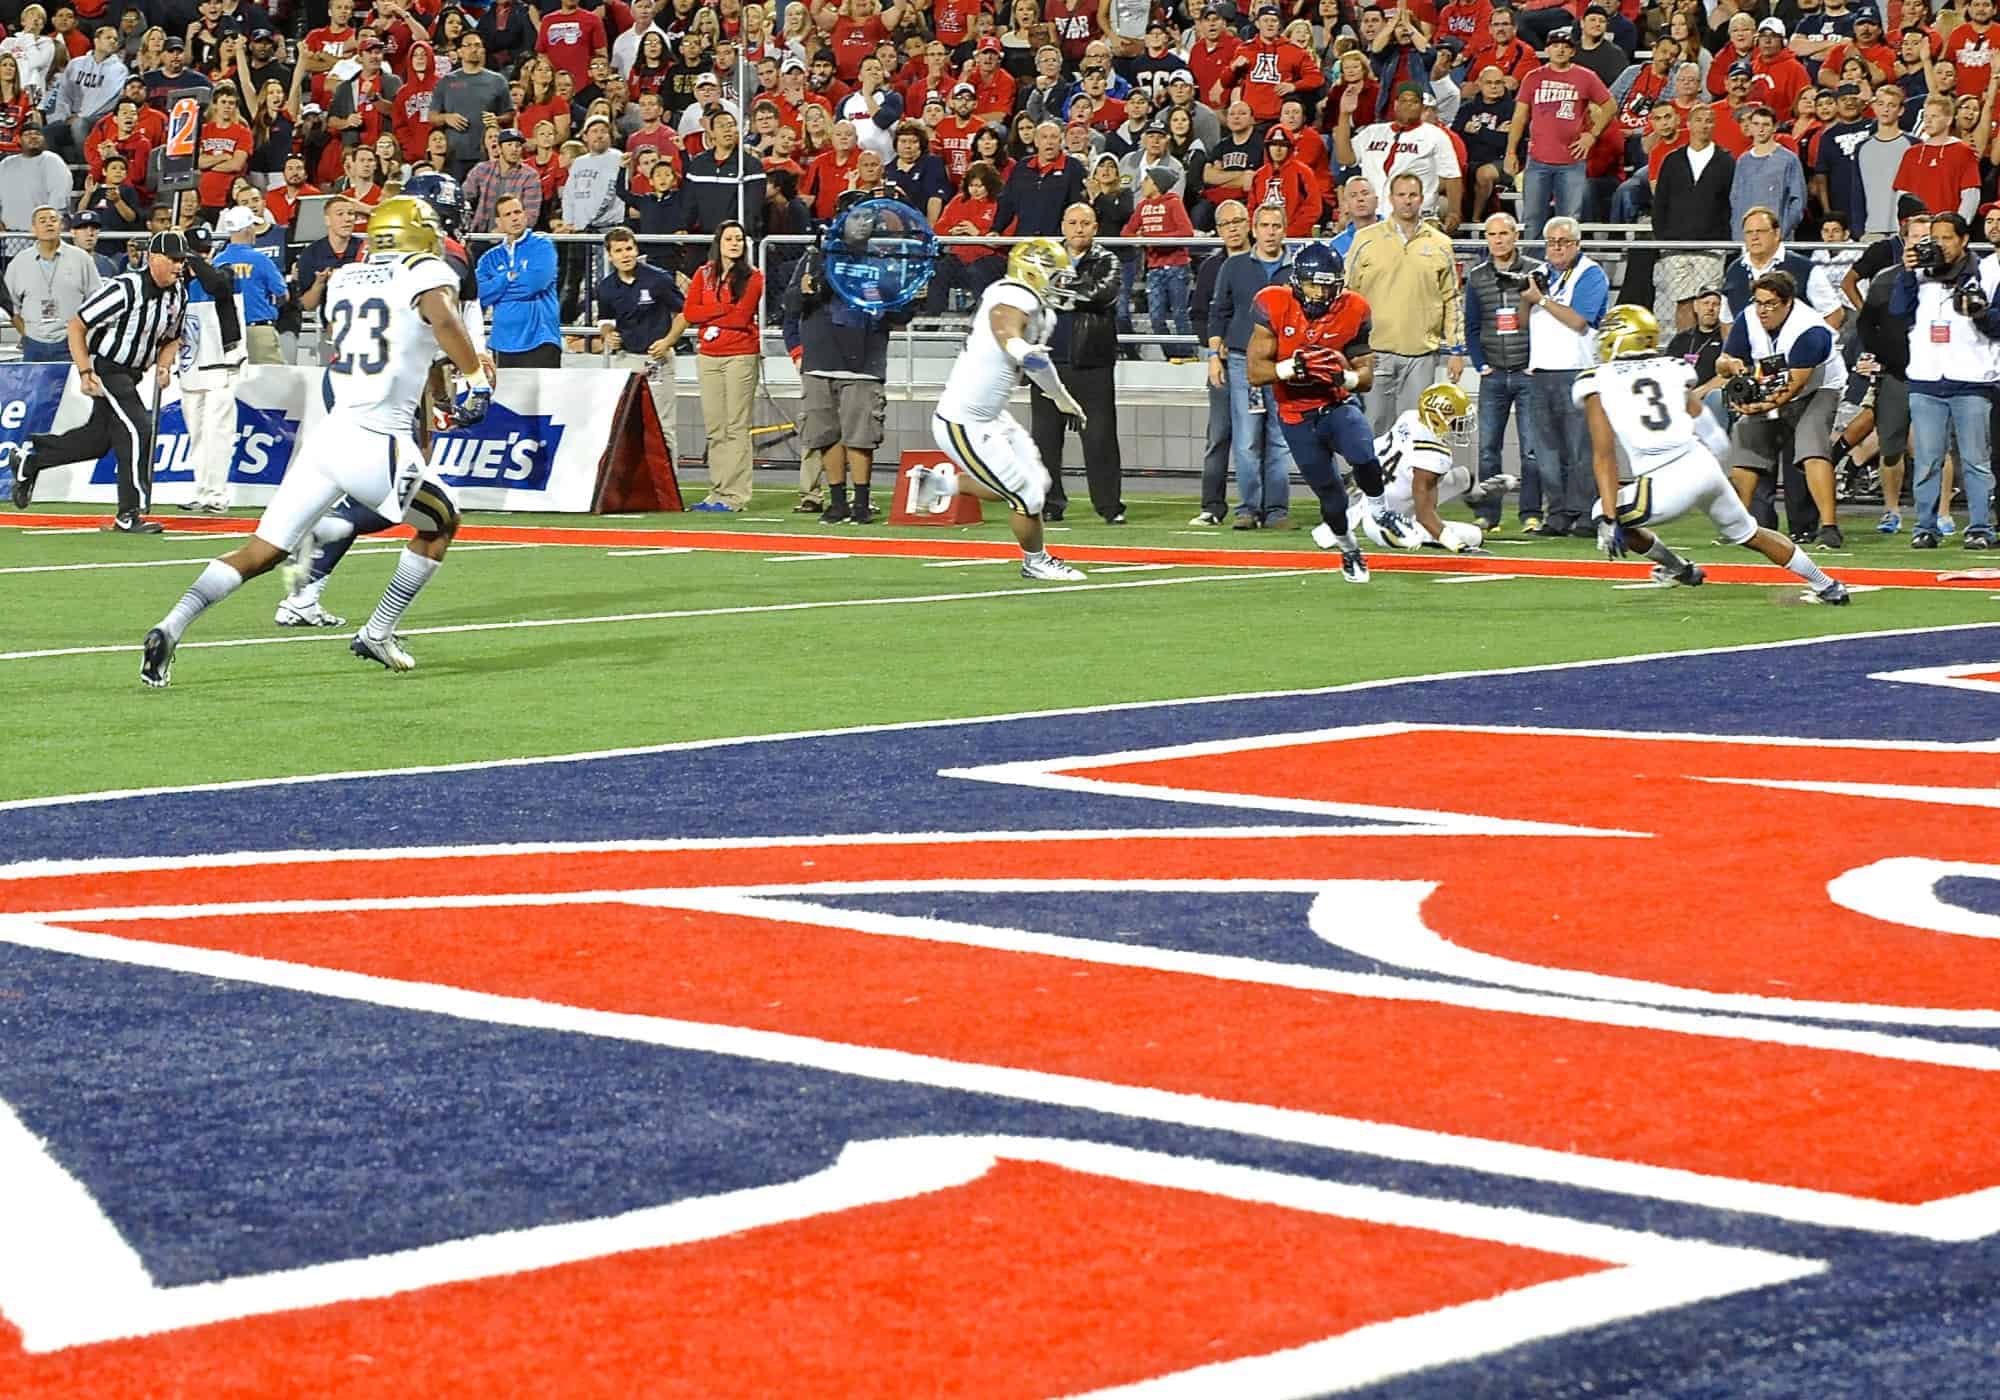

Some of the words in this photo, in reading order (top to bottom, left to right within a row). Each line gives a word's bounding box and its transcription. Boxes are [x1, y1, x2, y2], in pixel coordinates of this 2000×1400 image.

[1251, 53, 1281, 84] A
[166, 98, 200, 157] 2
[1264, 177, 1286, 205] A
[834, 262, 880, 281] ESPN
[331, 297, 391, 375] 23
[0, 400, 26, 429] e
[1631, 377, 1671, 432] 3
[434, 432, 537, 481] WE'S
